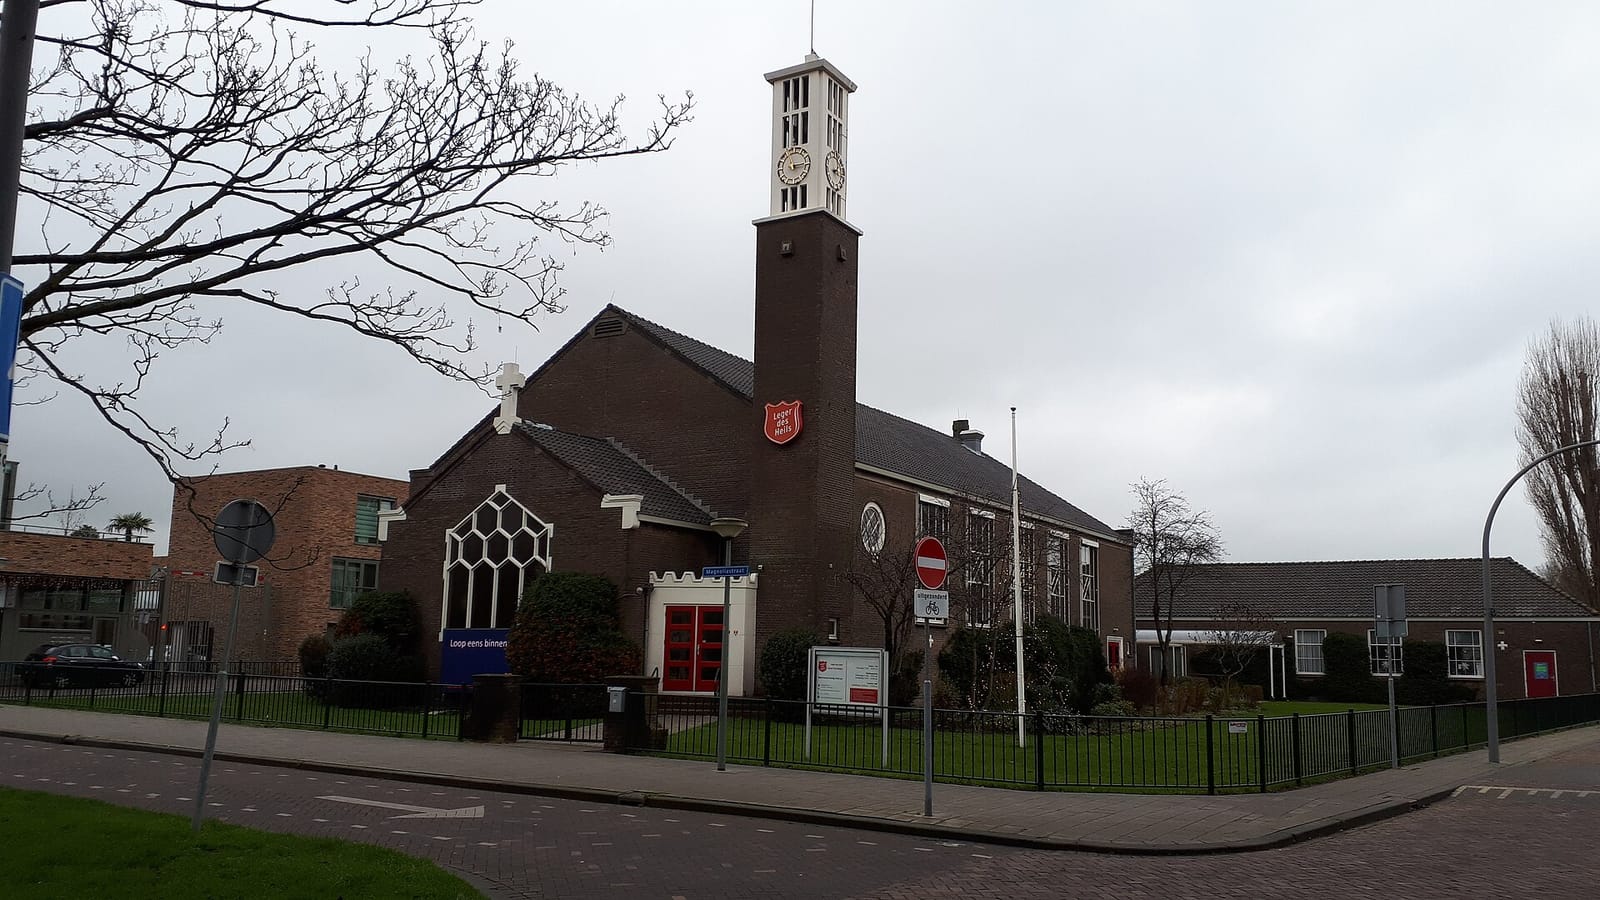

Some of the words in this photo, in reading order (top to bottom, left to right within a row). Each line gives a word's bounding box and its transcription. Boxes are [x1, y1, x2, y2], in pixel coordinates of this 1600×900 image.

[773, 408, 792, 420] Leger
[776, 418, 789, 427] des
[774, 425, 792, 436] Heils
[450, 639, 466, 648] Loop
[467, 640, 483, 648] eens
[484, 638, 508, 648] binnen
